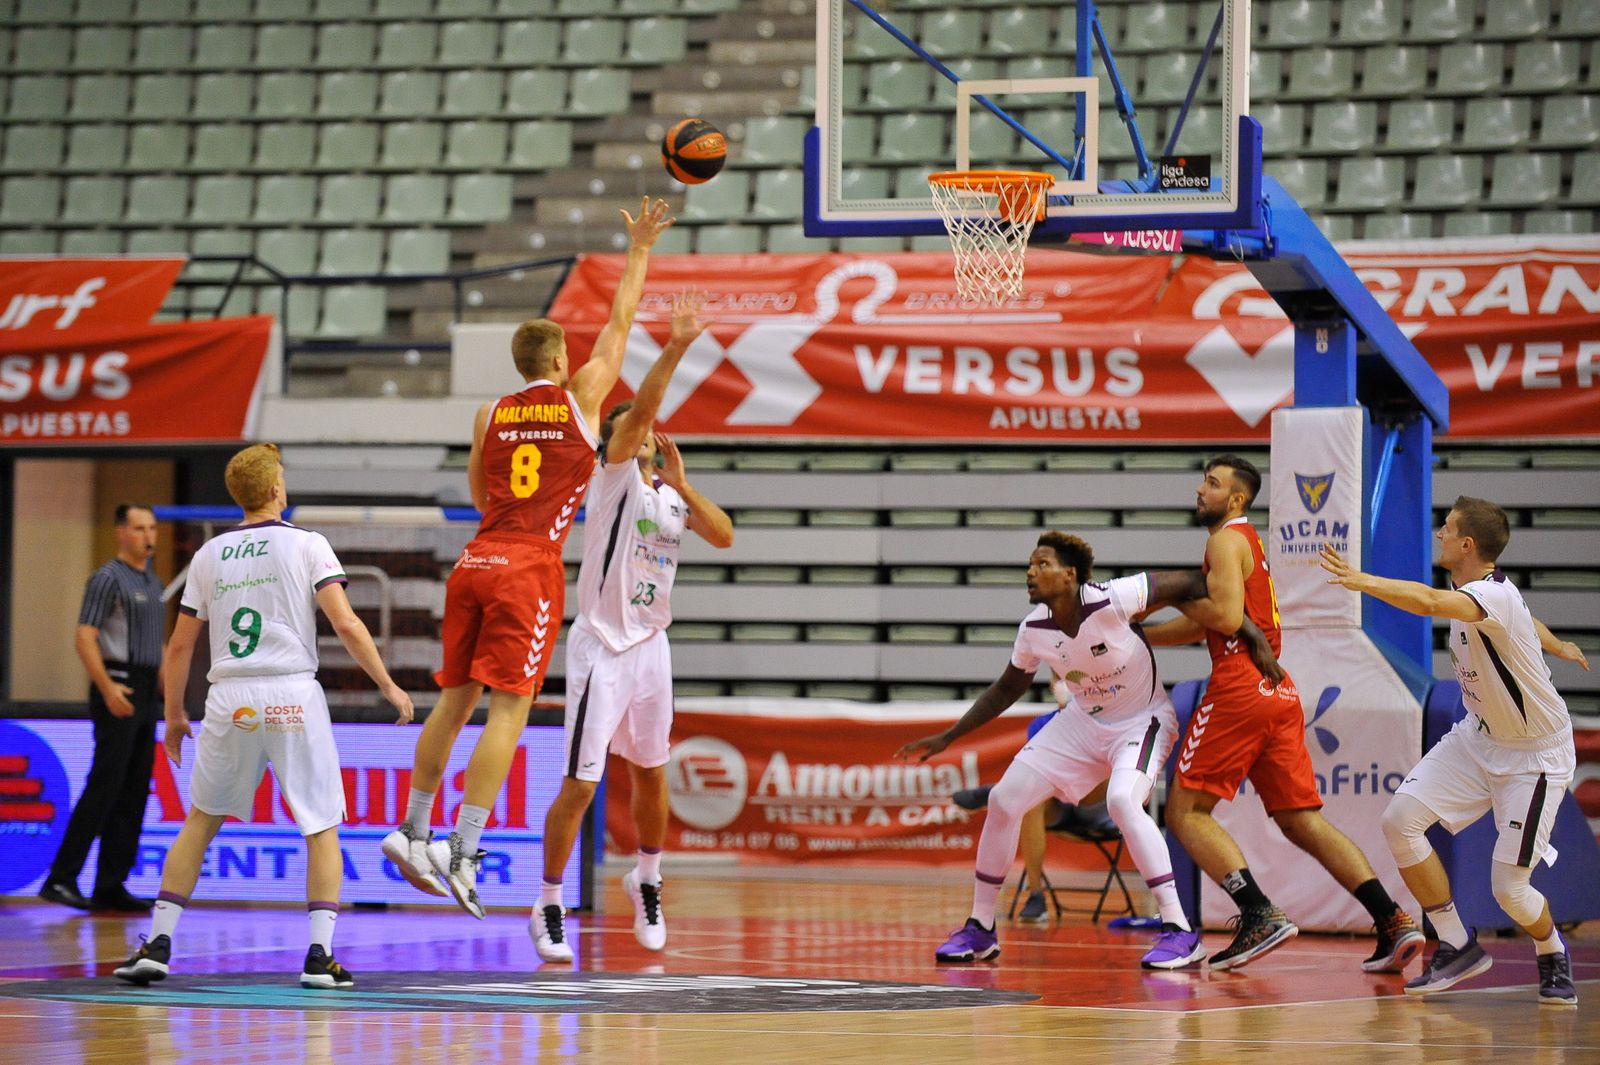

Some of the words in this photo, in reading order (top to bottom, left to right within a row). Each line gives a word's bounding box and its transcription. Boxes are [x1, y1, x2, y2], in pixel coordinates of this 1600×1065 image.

[1162, 164, 1184, 178] liga
[1162, 175, 1209, 188] endesa
[852, 345, 1145, 397] VERSUS
[494, 403, 570, 424] MALMANIS
[988, 406, 1142, 431] APUESTAS
[520, 430, 565, 440] VERSUS
[510, 443, 542, 499] 8
[1279, 519, 1350, 541] UCAM
[221, 540, 270, 561] DÍAZ
[630, 581, 657, 606] 23
[228, 606, 263, 659] 9
[264, 705, 305, 715] COSTA
[264, 716, 284, 725] DEL
[286, 716, 305, 725] SOL
[754, 751, 979, 799] Amounal
[762, 805, 853, 825] RENT
[866, 805, 891, 826] A
